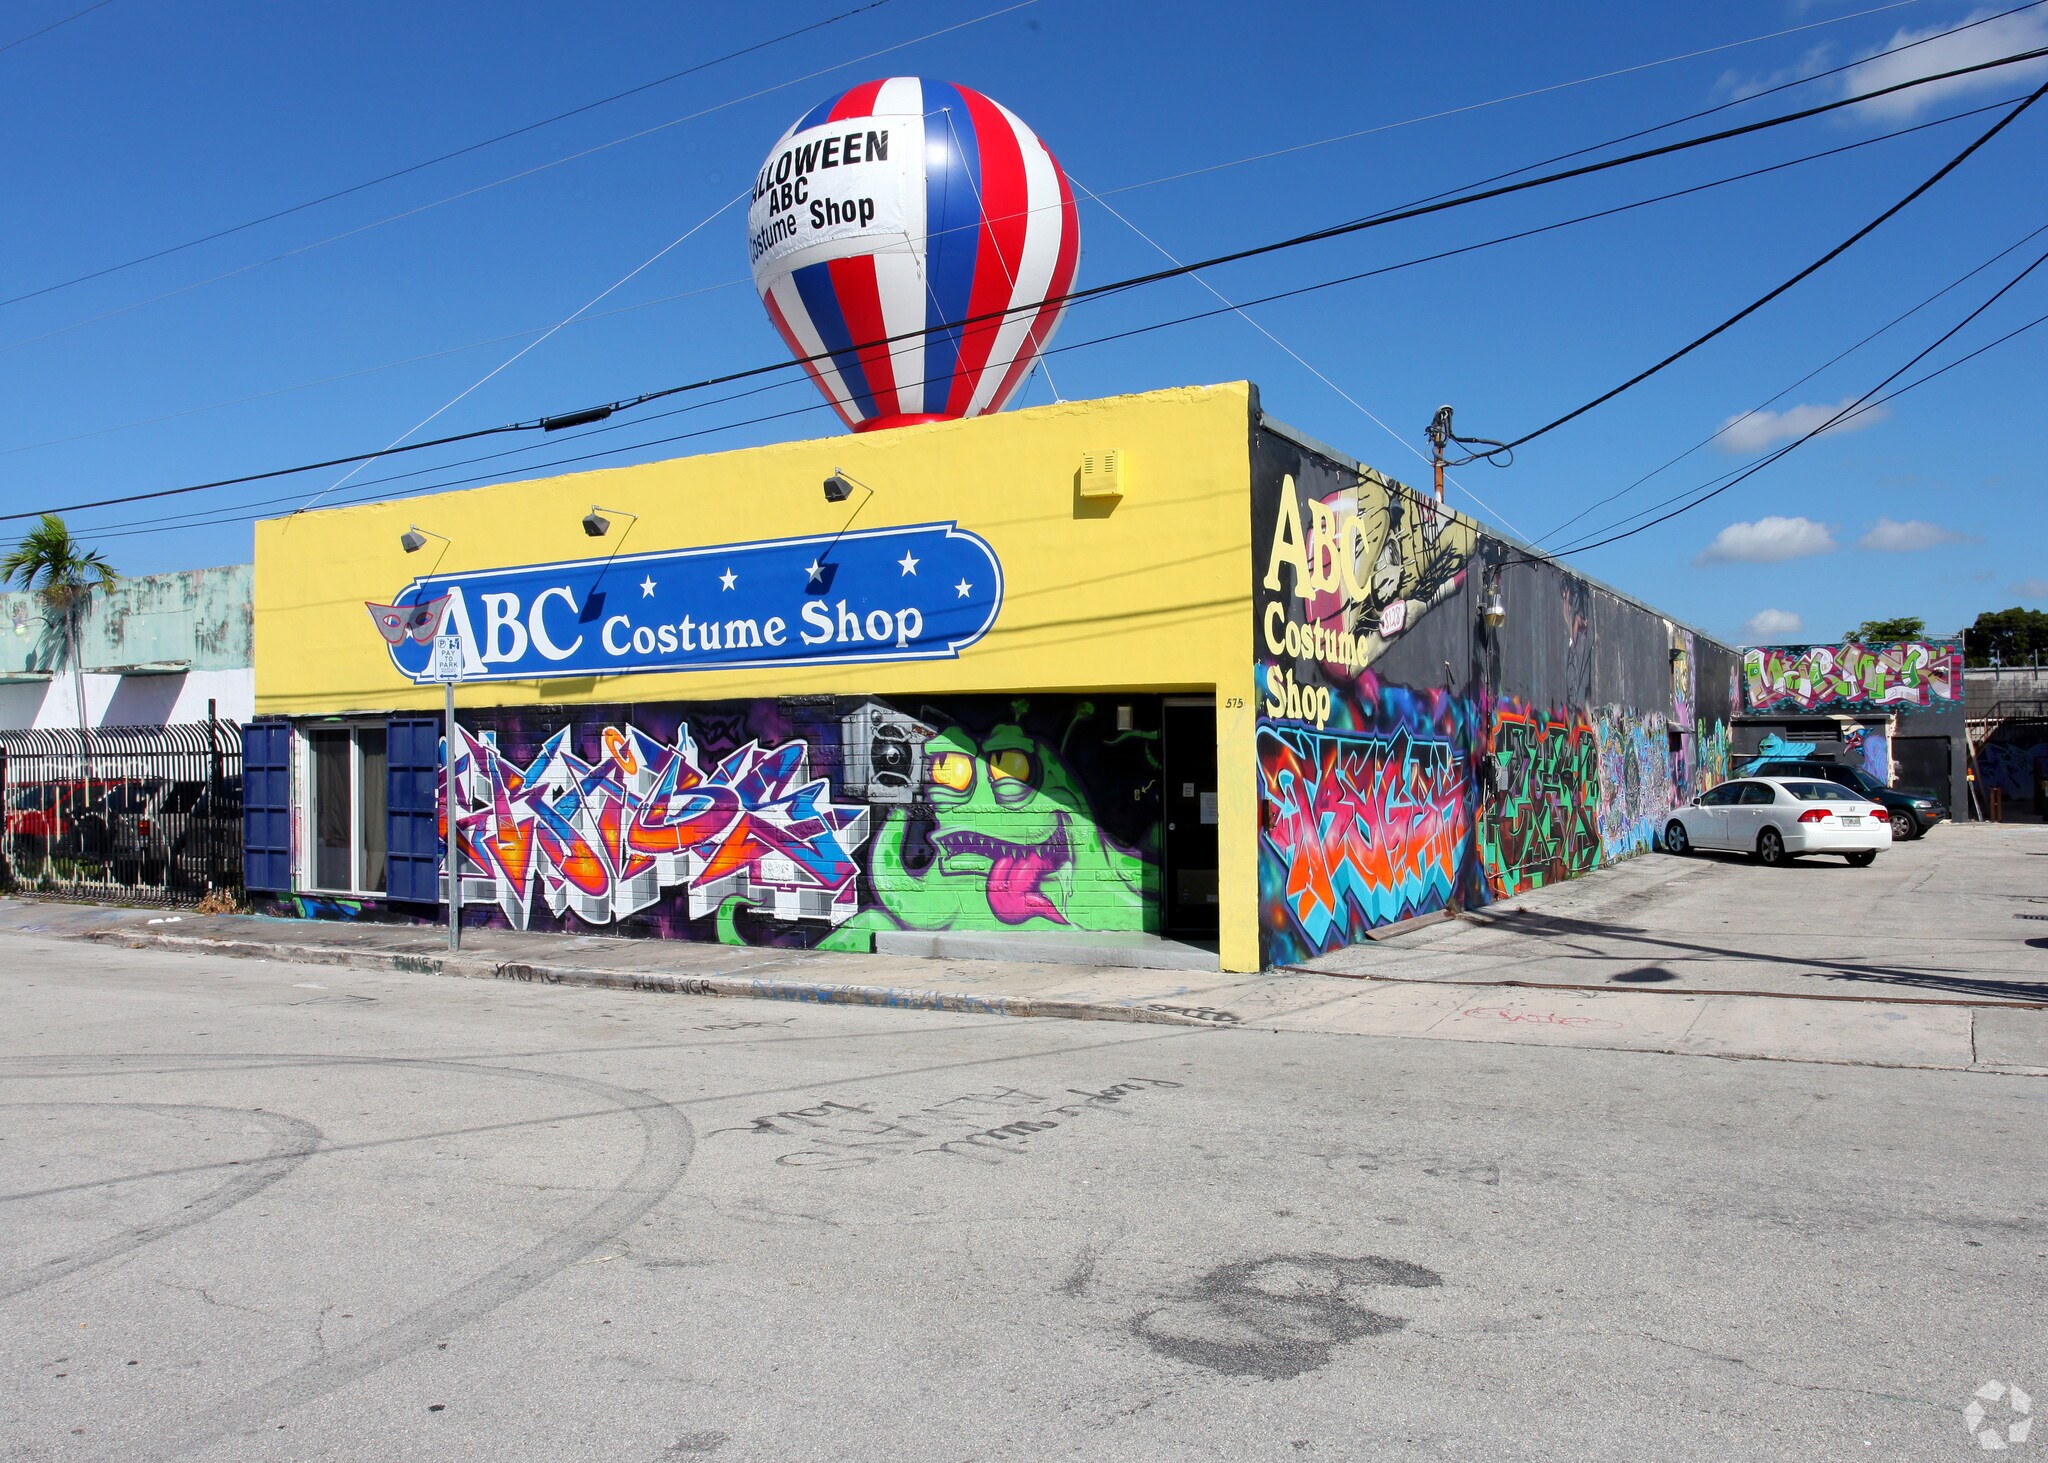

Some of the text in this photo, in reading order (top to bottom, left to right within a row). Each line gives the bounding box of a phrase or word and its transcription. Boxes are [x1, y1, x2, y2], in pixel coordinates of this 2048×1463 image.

[770, 176, 808, 217] ABC
[750, 197, 874, 265] Costume Shop
[1263, 473, 1371, 602] ABC
[420, 585, 925, 677] ABC Costume Shop
[1263, 600, 1369, 667] Costume
[1225, 698, 1244, 709] 575
[1266, 664, 1331, 731] Shop
